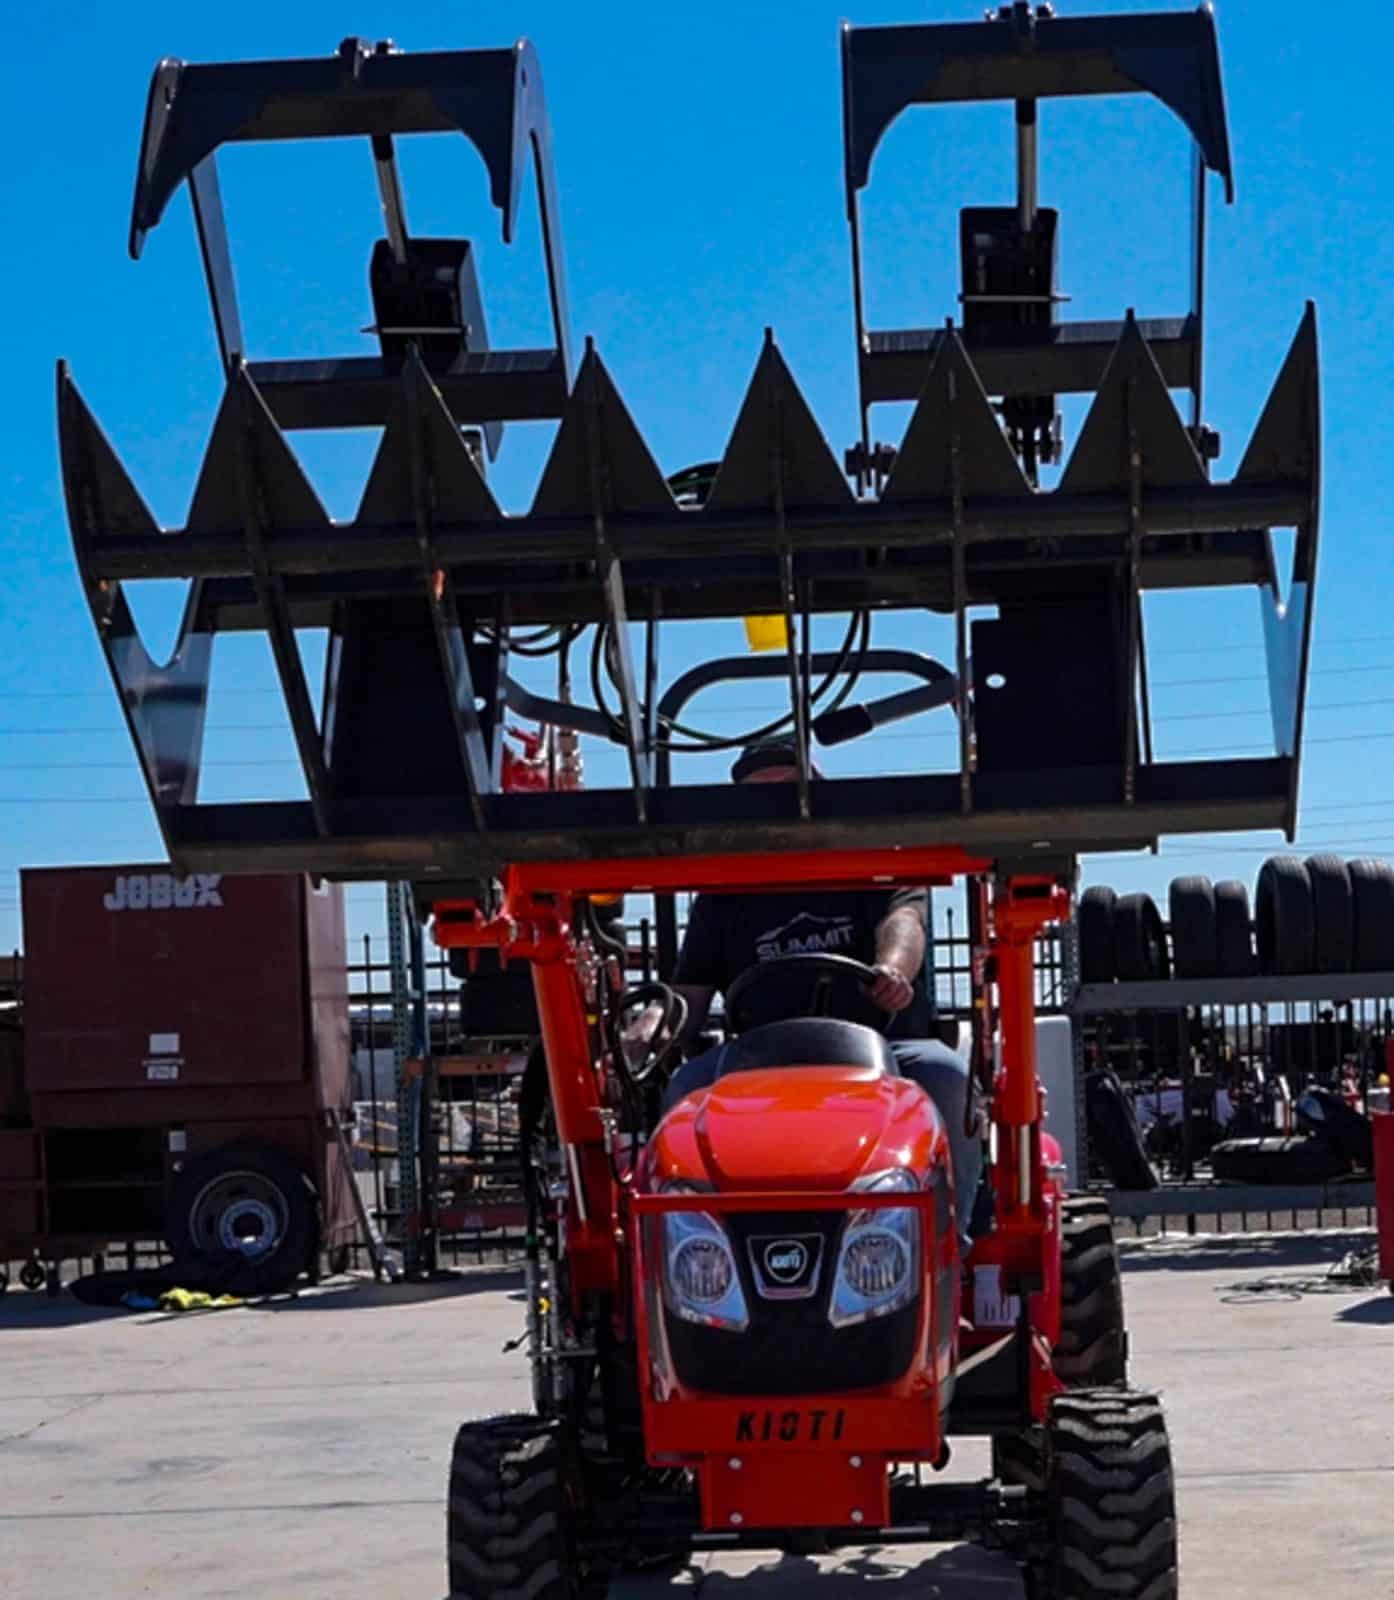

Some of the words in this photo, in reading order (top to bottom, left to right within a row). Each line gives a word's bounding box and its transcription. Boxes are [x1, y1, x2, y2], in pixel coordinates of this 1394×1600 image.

[104, 874, 224, 910] JOBOX
[757, 925, 854, 960] SUMMIT
[736, 1409, 846, 1442] KIOTI
